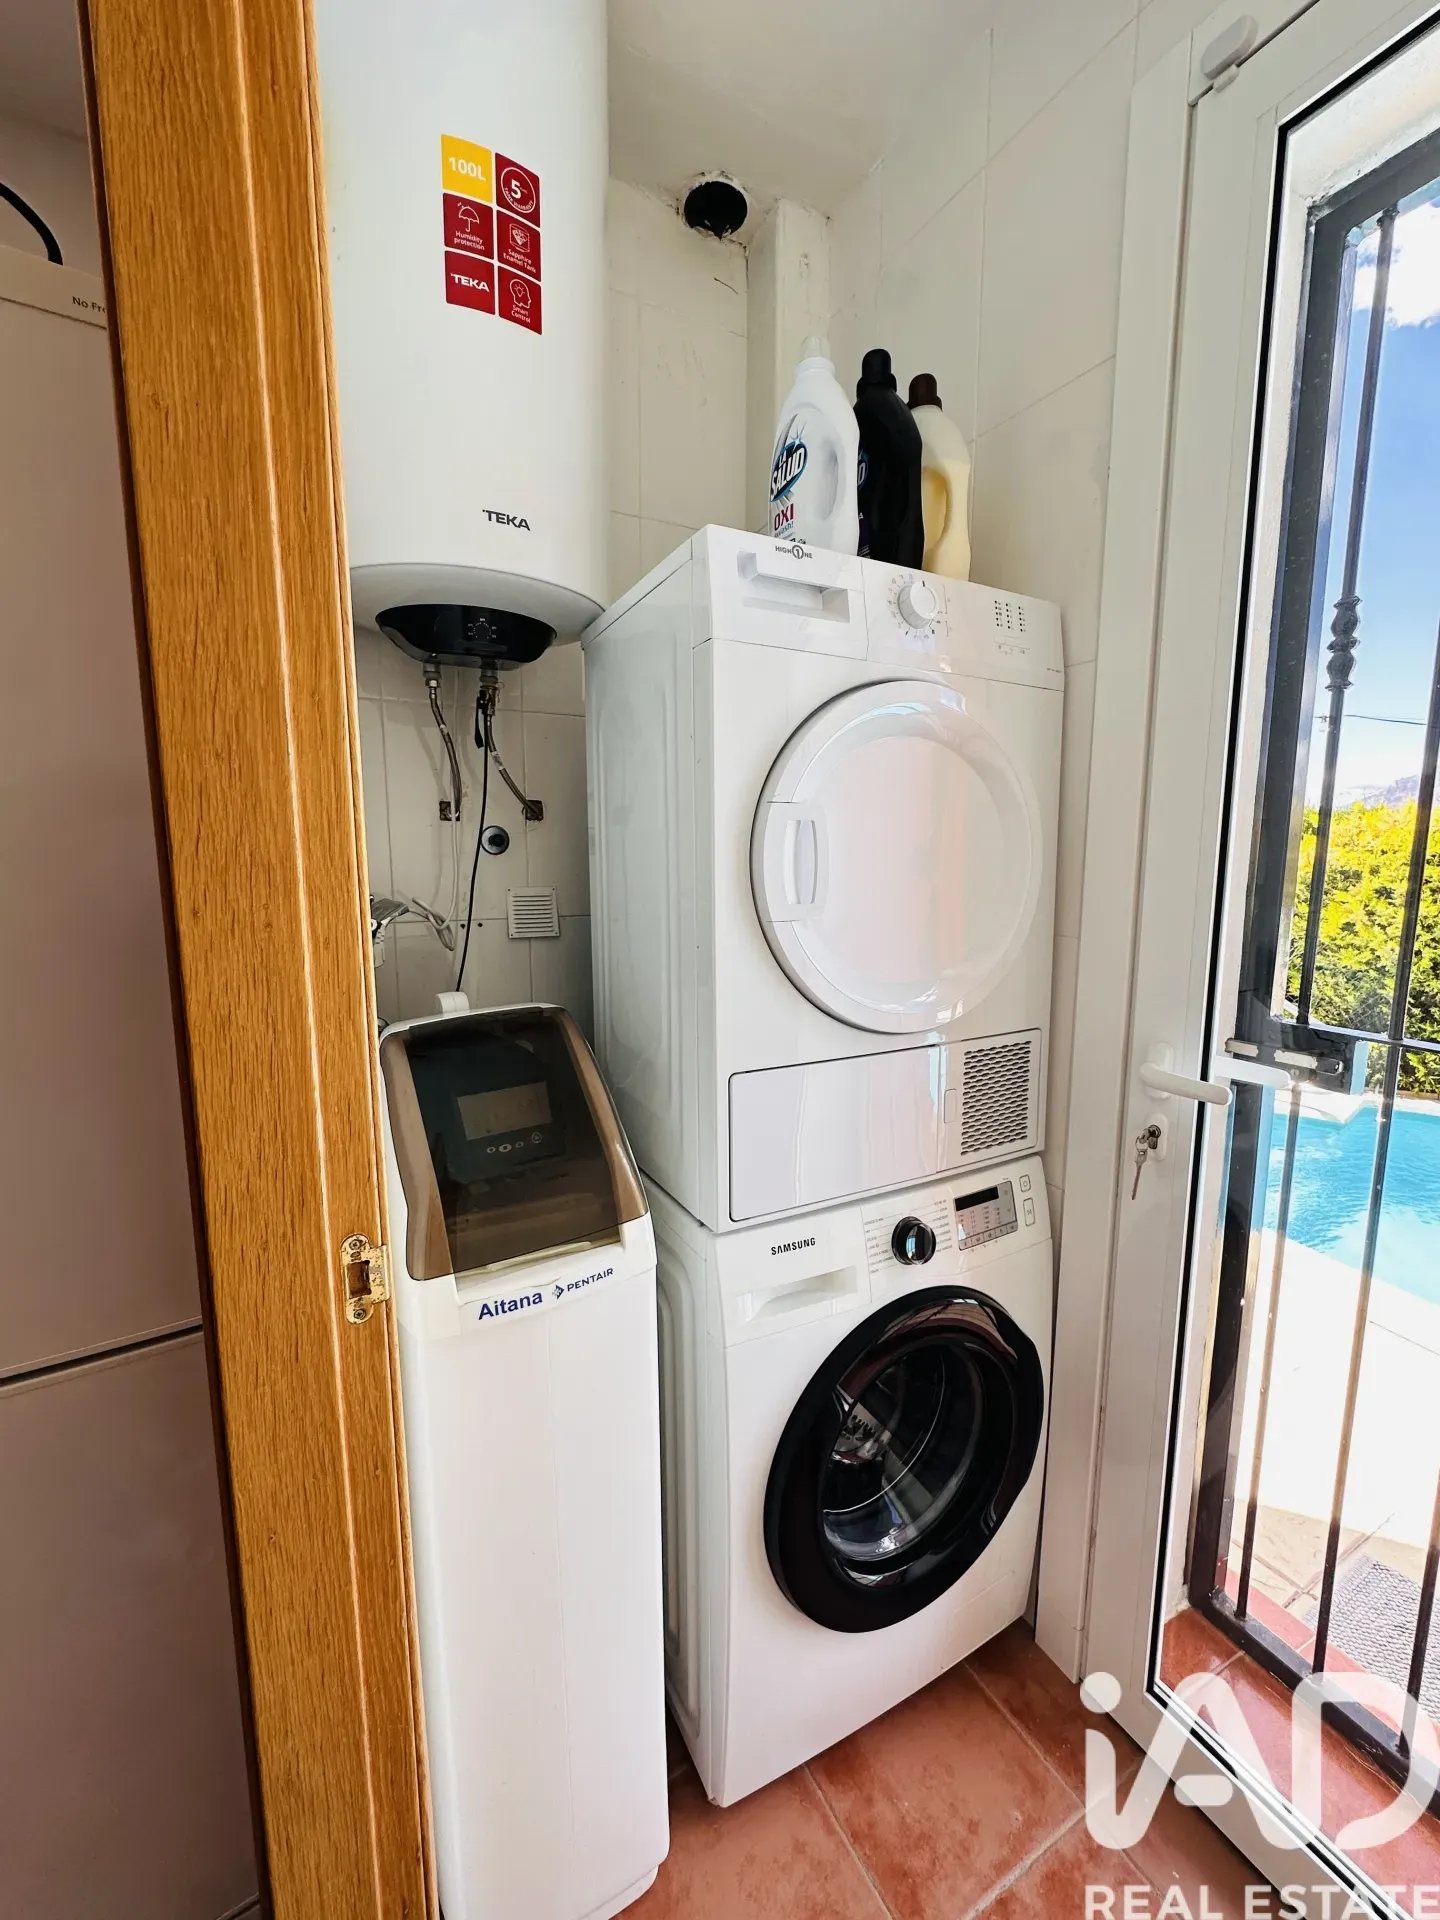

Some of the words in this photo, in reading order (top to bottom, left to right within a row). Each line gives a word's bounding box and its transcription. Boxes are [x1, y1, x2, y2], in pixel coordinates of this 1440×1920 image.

[449, 156, 487, 181] 100L
[511, 178, 522, 199] 5
[454, 237, 485, 251] protection
[455, 231, 483, 244] Humidity
[508, 248, 532, 265] Sapphire
[524, 262, 537, 274] Tank
[451, 273, 490, 293] TEKA
[72, 296, 89, 309] No
[512, 304, 529, 316] Smart
[511, 309, 531, 324] Control
[771, 447, 805, 496] SALUD
[482, 508, 531, 532] TEKA
[774, 503, 794, 532] OXI
[770, 1237, 816, 1257] SAMSUNG
[566, 1267, 614, 1293] PENTAIR
[478, 1291, 544, 1321] Aitana
